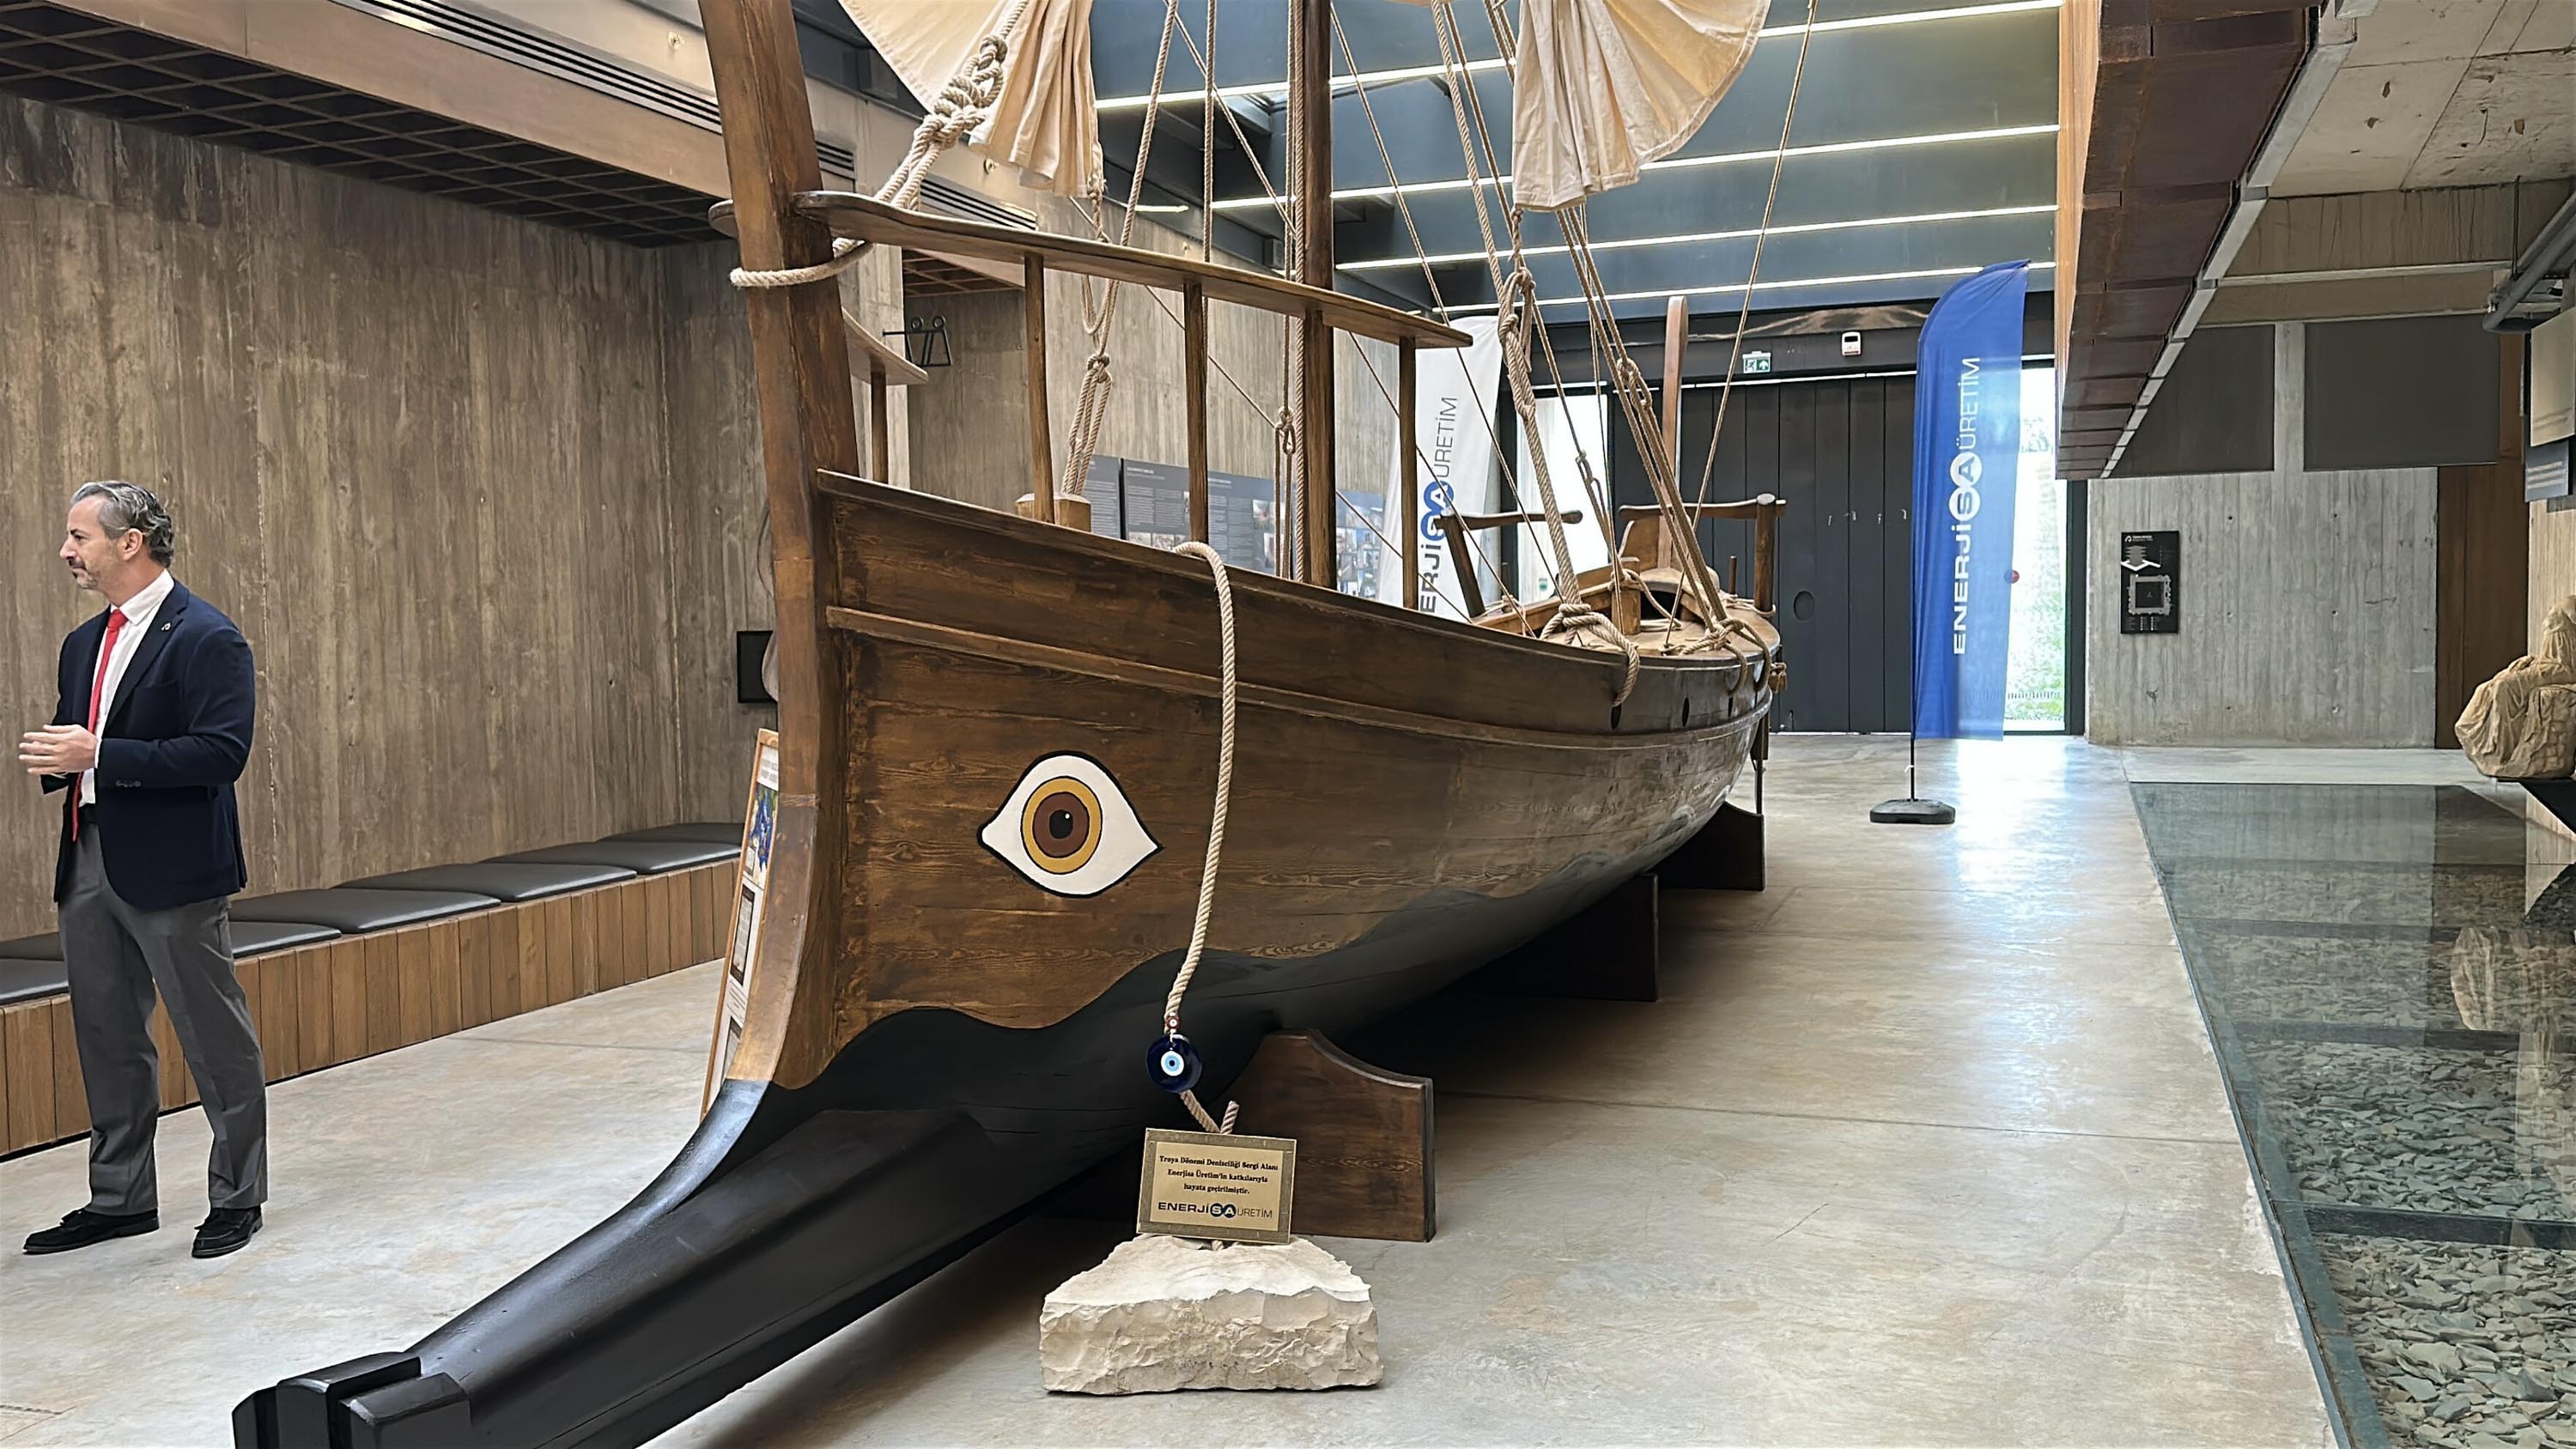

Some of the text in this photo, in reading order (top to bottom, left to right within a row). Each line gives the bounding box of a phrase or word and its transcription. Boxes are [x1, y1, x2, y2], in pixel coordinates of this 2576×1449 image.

[1948, 357, 1983, 655] ENERJİSA ÜRETİM
[1419, 480, 1455, 613] ERJİSA
[1159, 1155, 1179, 1164] Troya
[1206, 1159, 1241, 1168] Denizciliği
[1242, 1161, 1259, 1171] Sergi
[1168, 1168, 1194, 1179] Enerjisa
[1229, 1173, 1268, 1183] katkılarıyla
[1184, 1183, 1250, 1194] hayata geçirilmiştir.
[1158, 1201, 1236, 1219] ENERJİSA
